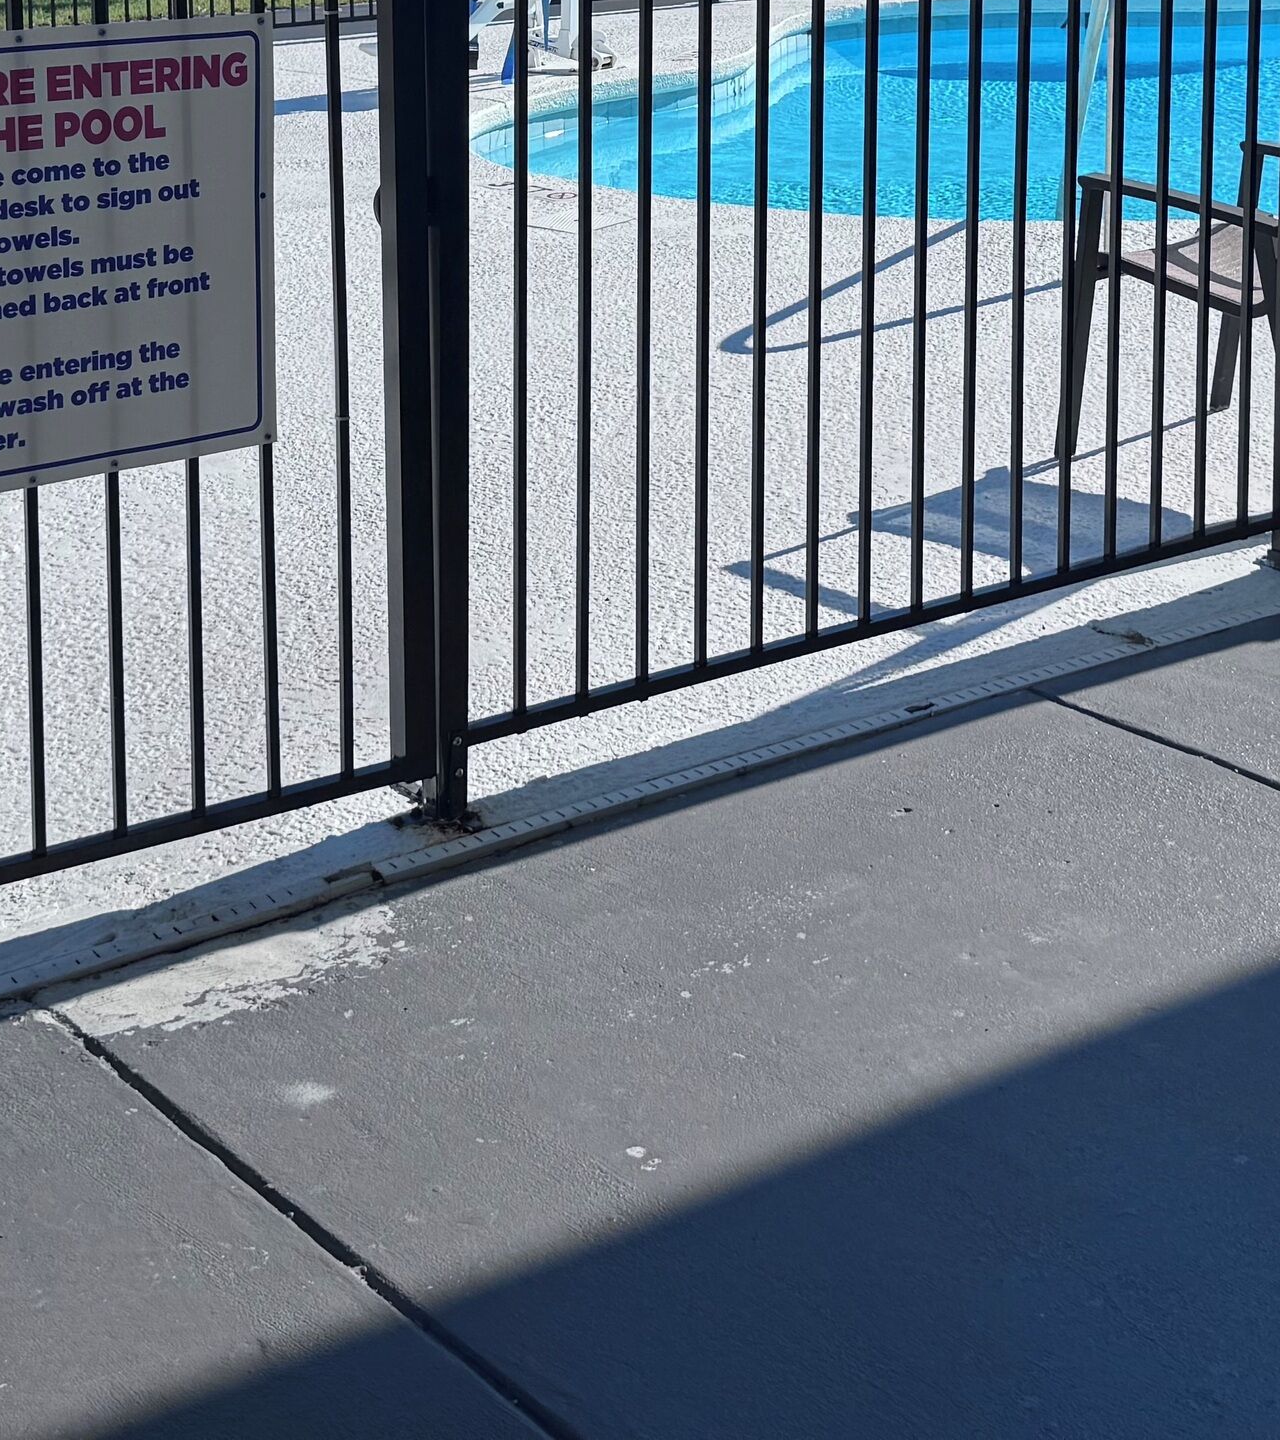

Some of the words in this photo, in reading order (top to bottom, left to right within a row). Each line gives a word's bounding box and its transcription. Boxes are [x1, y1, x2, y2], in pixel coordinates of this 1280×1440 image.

[46, 51, 248, 102] ENTERING
[54, 104, 167, 148] POOL
[11, 161, 86, 186] come
[93, 157, 121, 178] to
[128, 151, 170, 174] the
[61, 193, 90, 213] to
[96, 186, 152, 211] sign
[158, 178, 200, 202] out
[91, 247, 157, 275] must
[163, 244, 194, 265] be
[43, 286, 108, 313] back
[114, 281, 141, 304] at
[147, 271, 211, 299] front
[20, 349, 133, 382] entering
[138, 341, 181, 364] the
[70, 380, 111, 406] off
[116, 376, 143, 400] at
[148, 371, 190, 394] the
